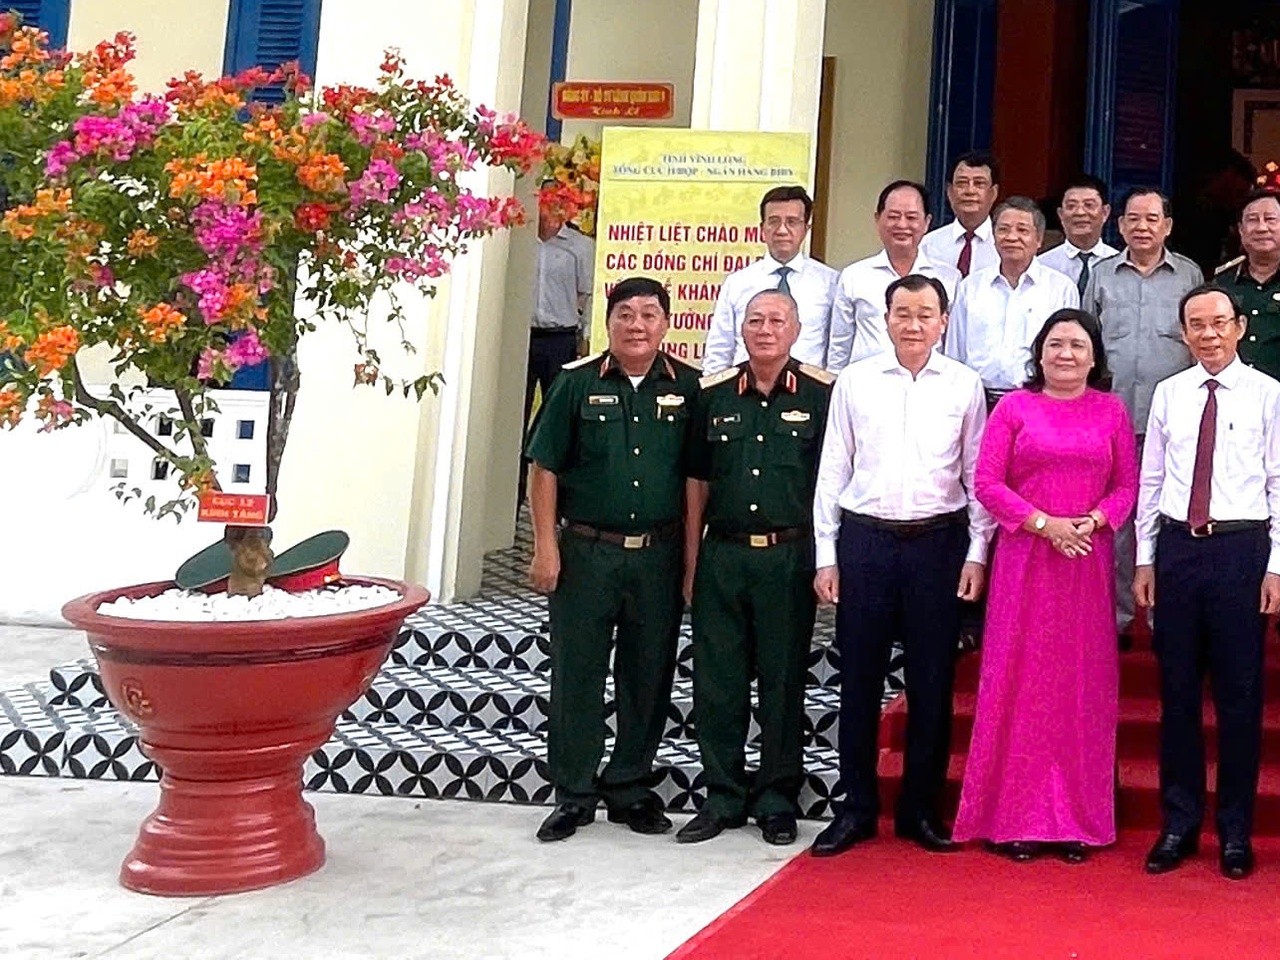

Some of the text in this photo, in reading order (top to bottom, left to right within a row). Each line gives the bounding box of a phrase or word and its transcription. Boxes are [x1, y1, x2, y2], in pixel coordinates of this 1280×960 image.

[609, 222, 654, 245] NHIỆT
[659, 222, 691, 246] LIỆT
[696, 222, 738, 244] CHÀO
[606, 251, 637, 271] CÁC
[643, 248, 686, 272] ĐỒNG
[692, 251, 718, 272] CHÍ
[678, 280, 721, 300] KHÁN
